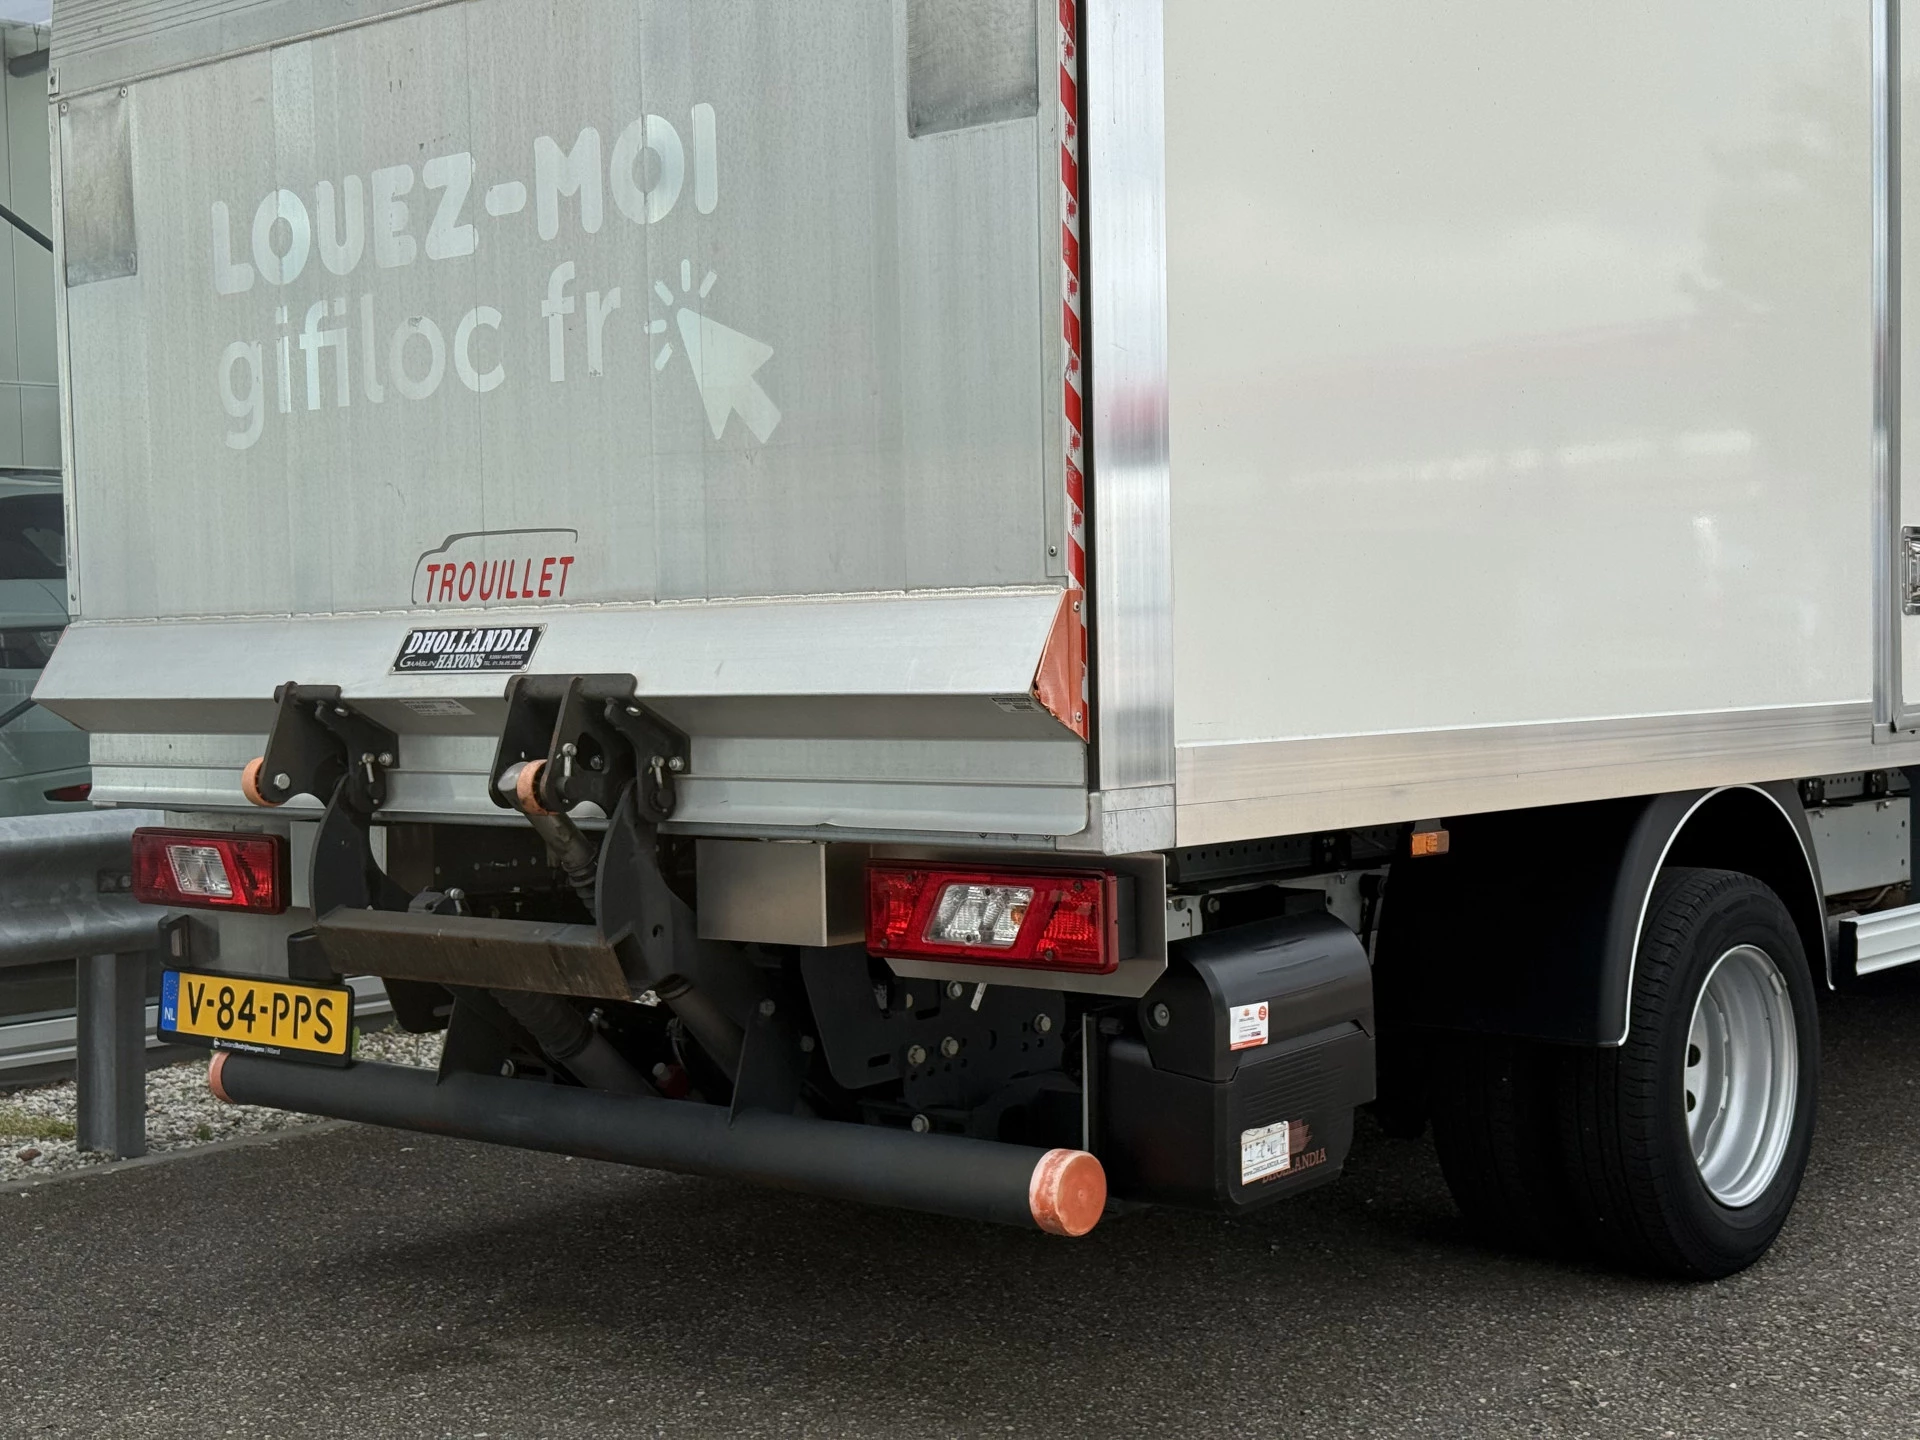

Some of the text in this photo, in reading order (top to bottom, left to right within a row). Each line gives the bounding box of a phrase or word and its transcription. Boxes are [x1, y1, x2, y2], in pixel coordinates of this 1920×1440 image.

[211, 102, 718, 295] LOUEZ-MOI
[541, 261, 621, 382] fr
[426, 556, 575, 603] TROUILLET
[405, 628, 533, 655] DHOLLANDIA
[434, 653, 485, 669] HAYONS
[164, 981, 333, 1045] NL V-84-PPS
